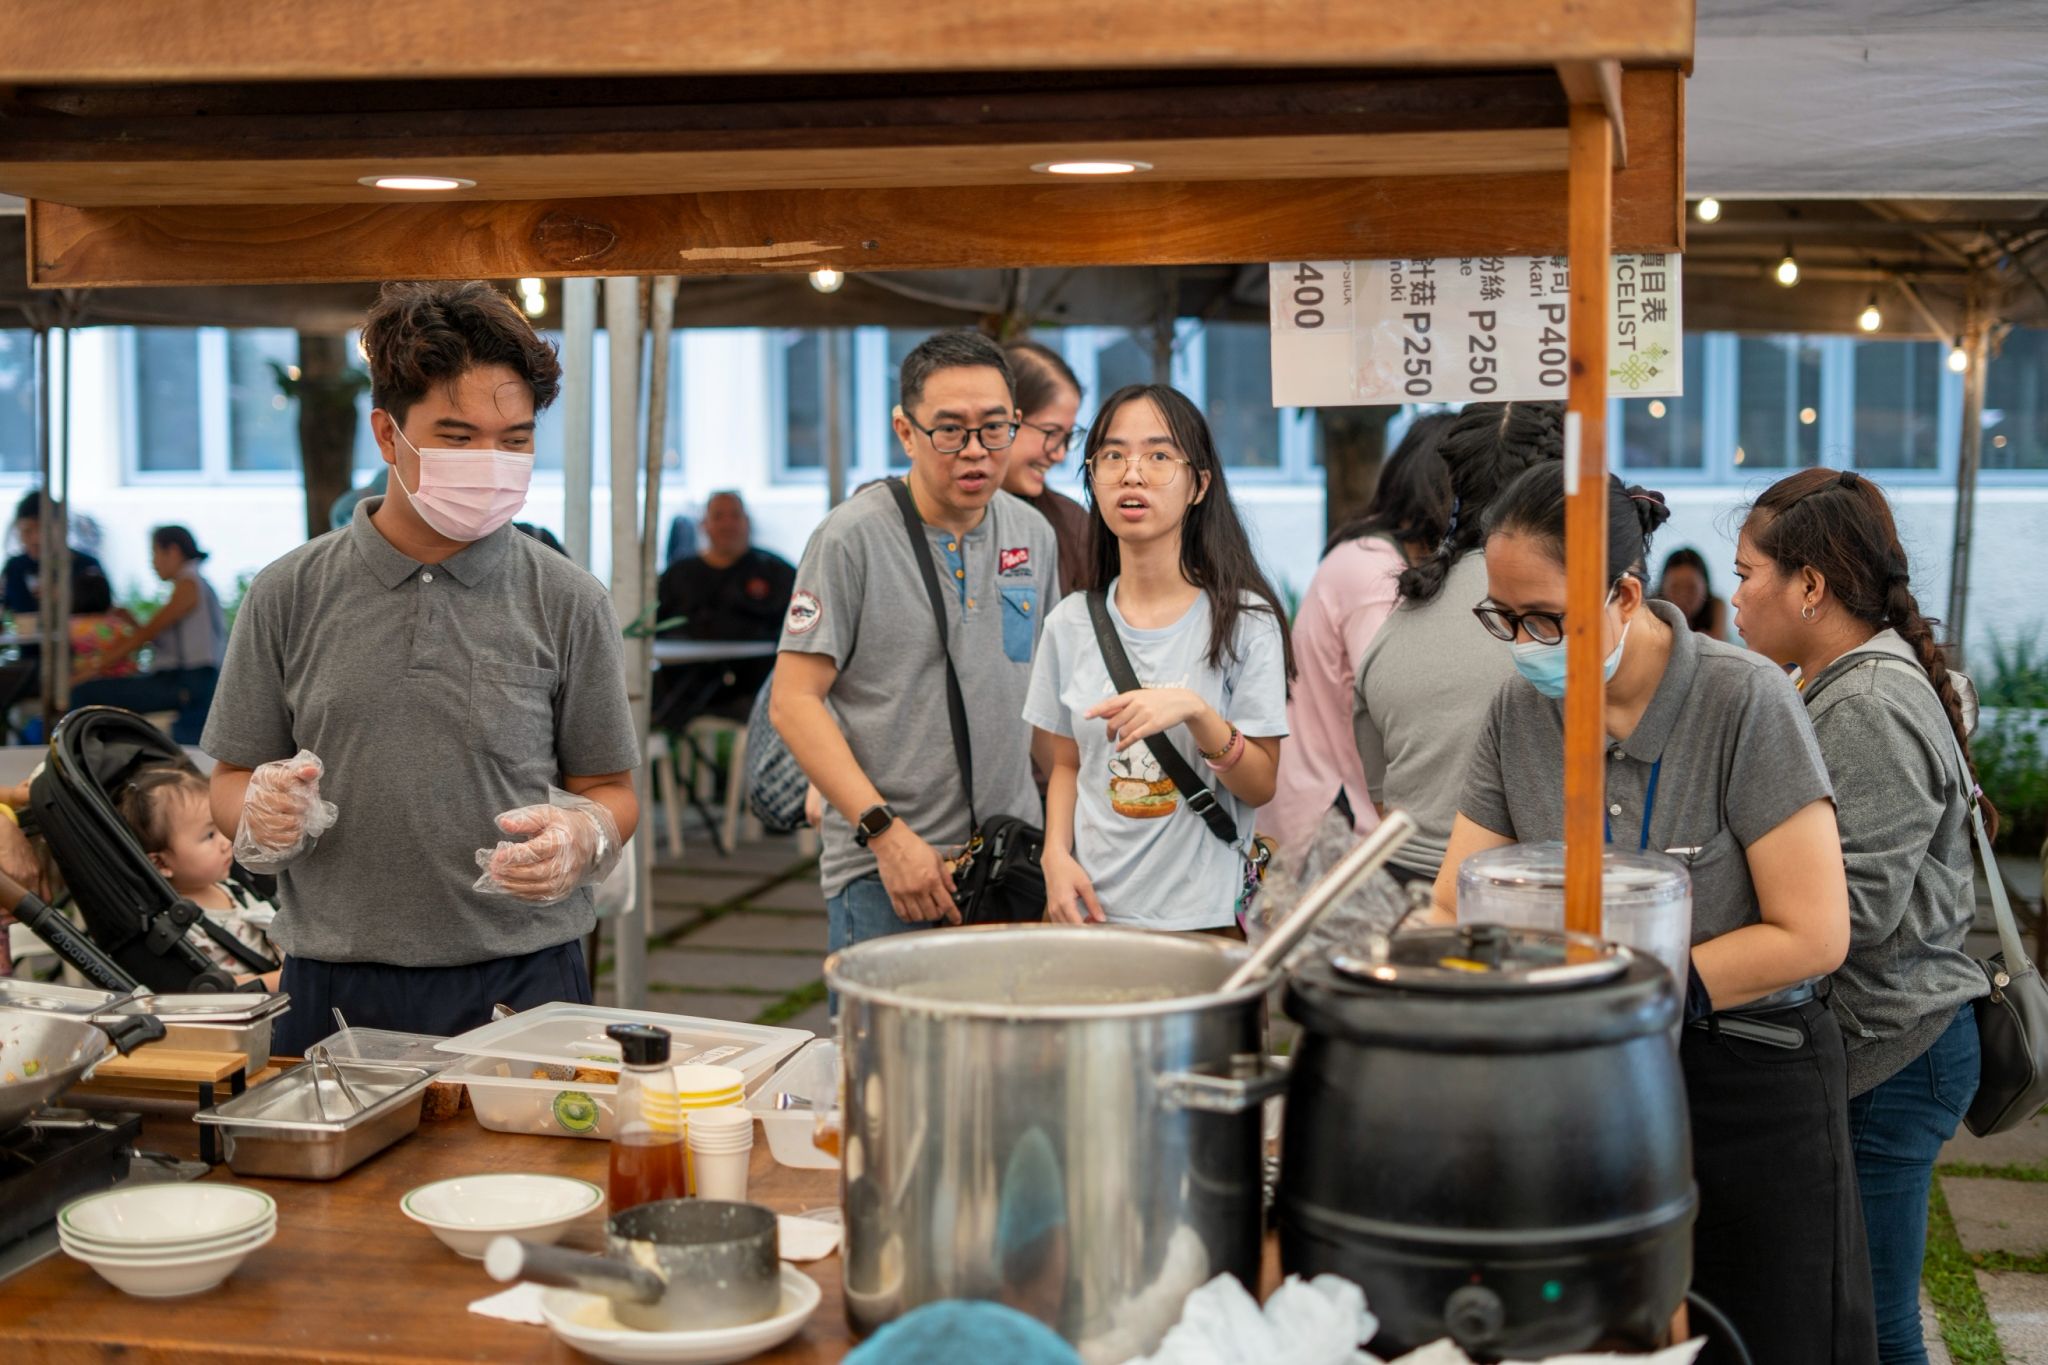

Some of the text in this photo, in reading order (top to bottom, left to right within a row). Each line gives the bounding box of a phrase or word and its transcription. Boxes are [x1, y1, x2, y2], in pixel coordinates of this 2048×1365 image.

[1293, 262, 1325, 329] 400
[1529, 256, 1546, 297] kari
[1617, 254, 1636, 351] ICELIST
[1403, 312, 1432, 396] P250
[1468, 311, 1498, 395] P250
[1537, 303, 1567, 387] P400
[61, 939, 117, 988] babybee
